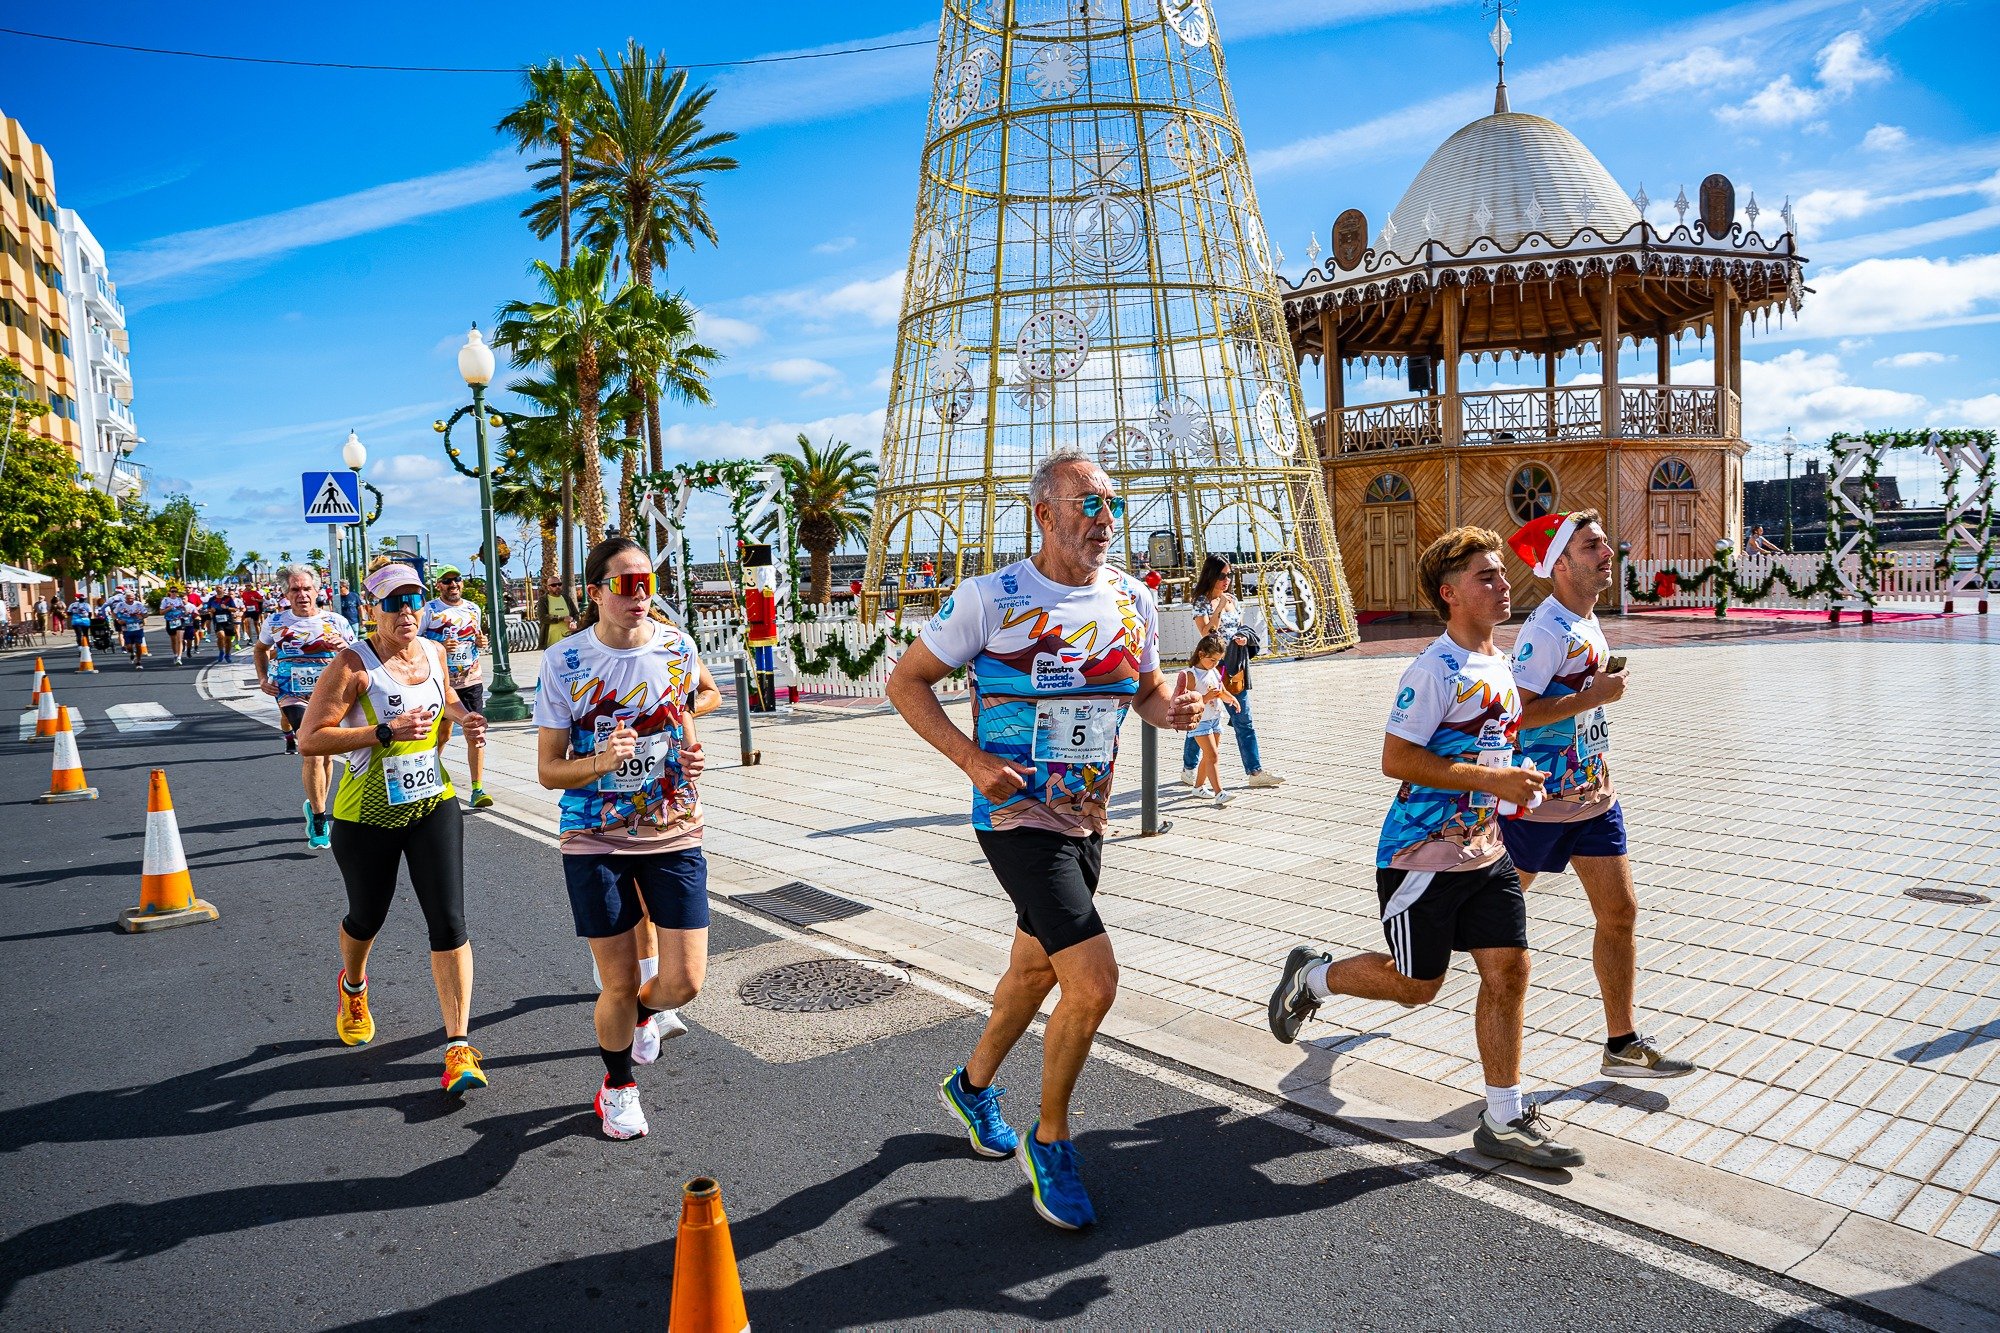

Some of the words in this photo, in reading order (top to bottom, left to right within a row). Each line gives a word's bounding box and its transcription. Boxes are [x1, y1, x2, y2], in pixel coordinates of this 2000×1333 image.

[998, 600, 1030, 610] Arrecife
[1036, 659, 1054, 667] San
[1036, 666, 1074, 674] Silvestre
[1036, 673, 1069, 681] Ciudad
[1036, 681, 1073, 689] Arrecife
[1071, 725, 1086, 746] 5
[403, 768, 434, 789] 826
